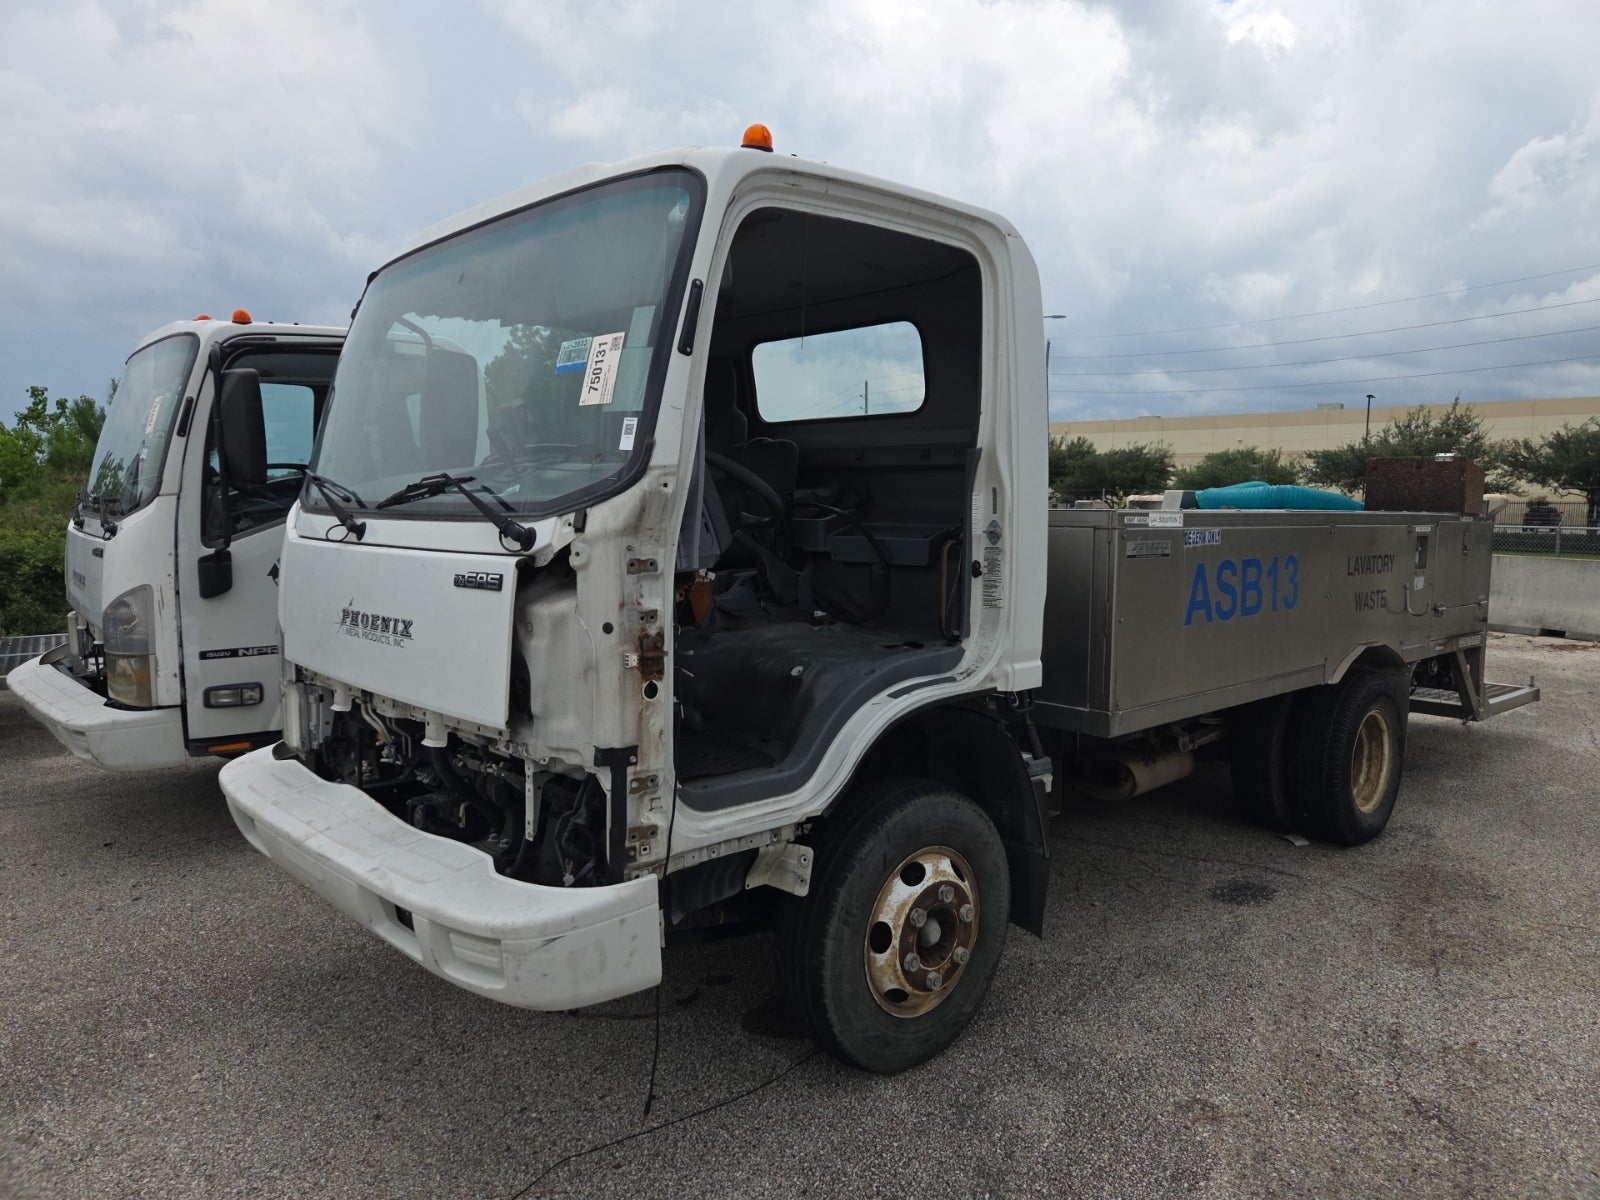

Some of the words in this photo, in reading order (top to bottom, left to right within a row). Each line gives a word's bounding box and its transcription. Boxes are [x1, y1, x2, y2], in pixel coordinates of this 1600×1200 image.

[588, 341, 608, 394] 750131
[1208, 530, 1220, 544] ONLY
[1347, 554, 1395, 576] LAVATORY
[465, 572, 500, 590] GAS
[1184, 554, 1298, 626] ASB13
[1354, 589, 1387, 612] WASTE
[341, 608, 414, 637] PHOENIX
[206, 650, 231, 658] ISUZU
